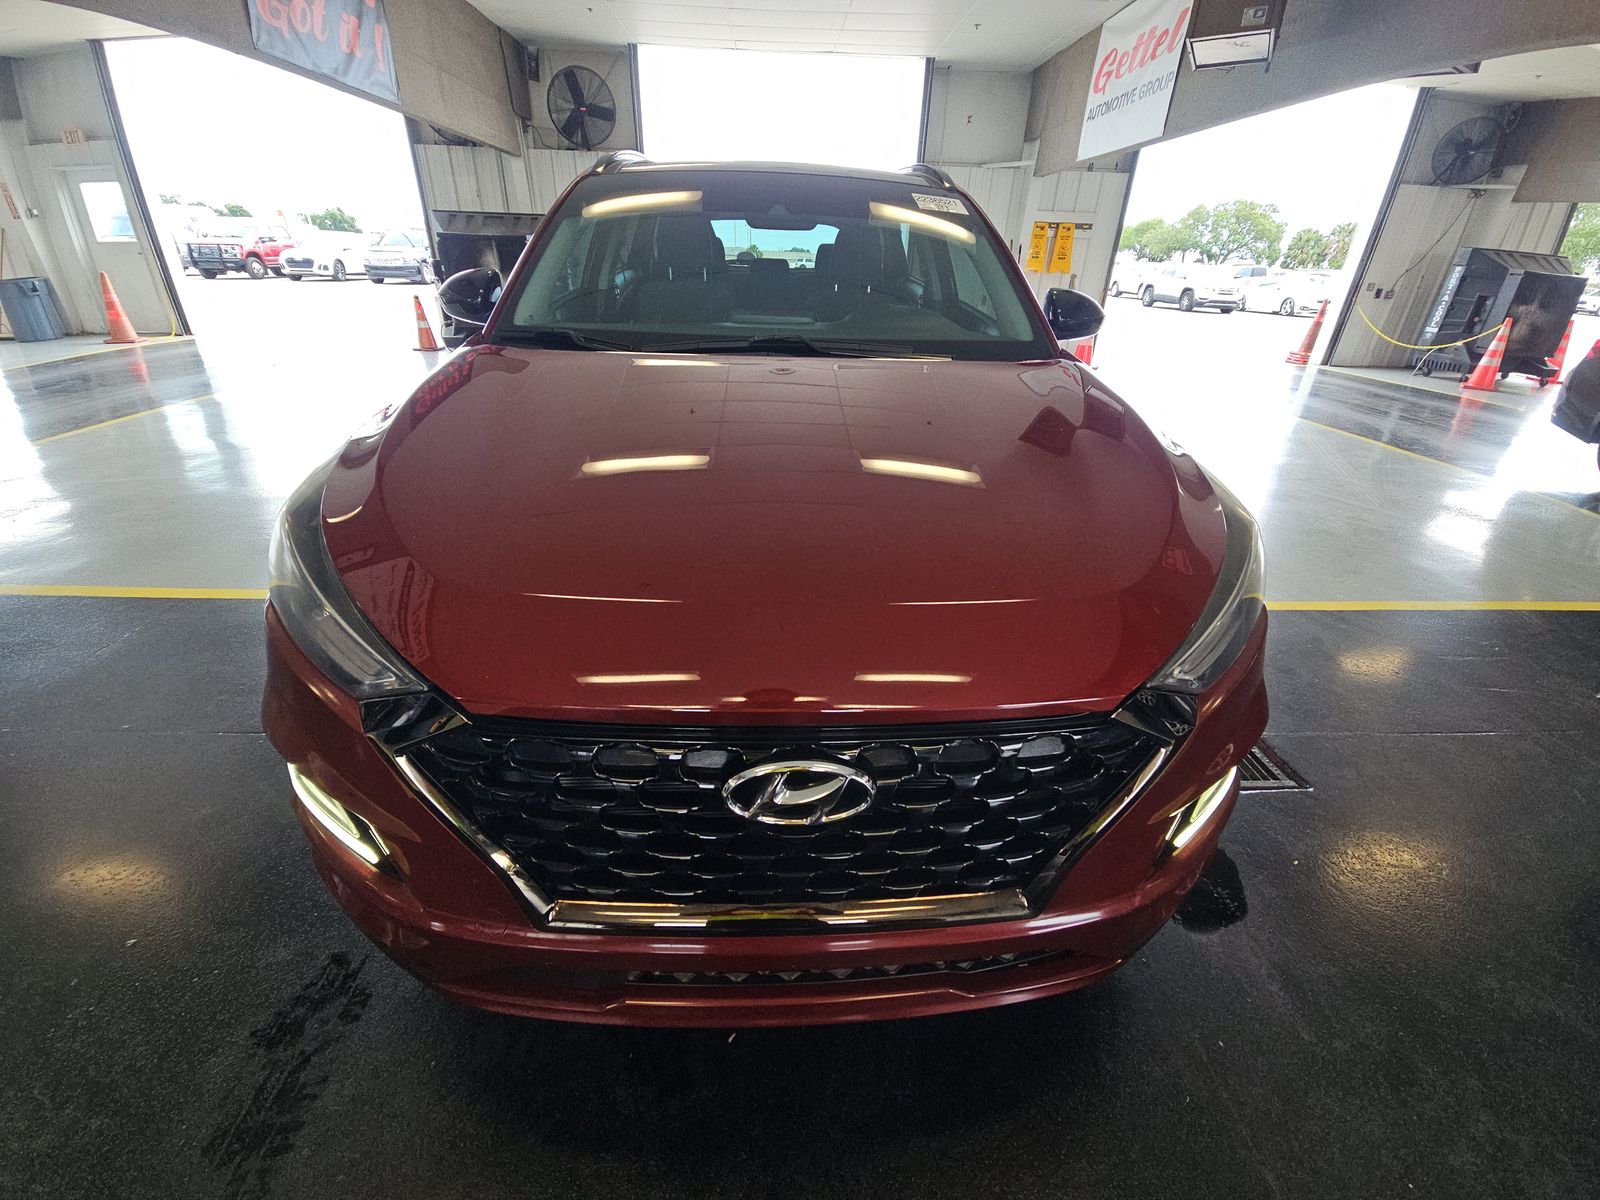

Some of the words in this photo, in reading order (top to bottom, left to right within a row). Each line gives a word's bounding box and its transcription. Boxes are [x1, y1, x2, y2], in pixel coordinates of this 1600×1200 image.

[1093, 7, 1191, 95] Gettel
[1086, 87, 1138, 122] AUTOMOTIVE
[1138, 71, 1175, 101] GROUP
[64, 130, 81, 144] EXIT
